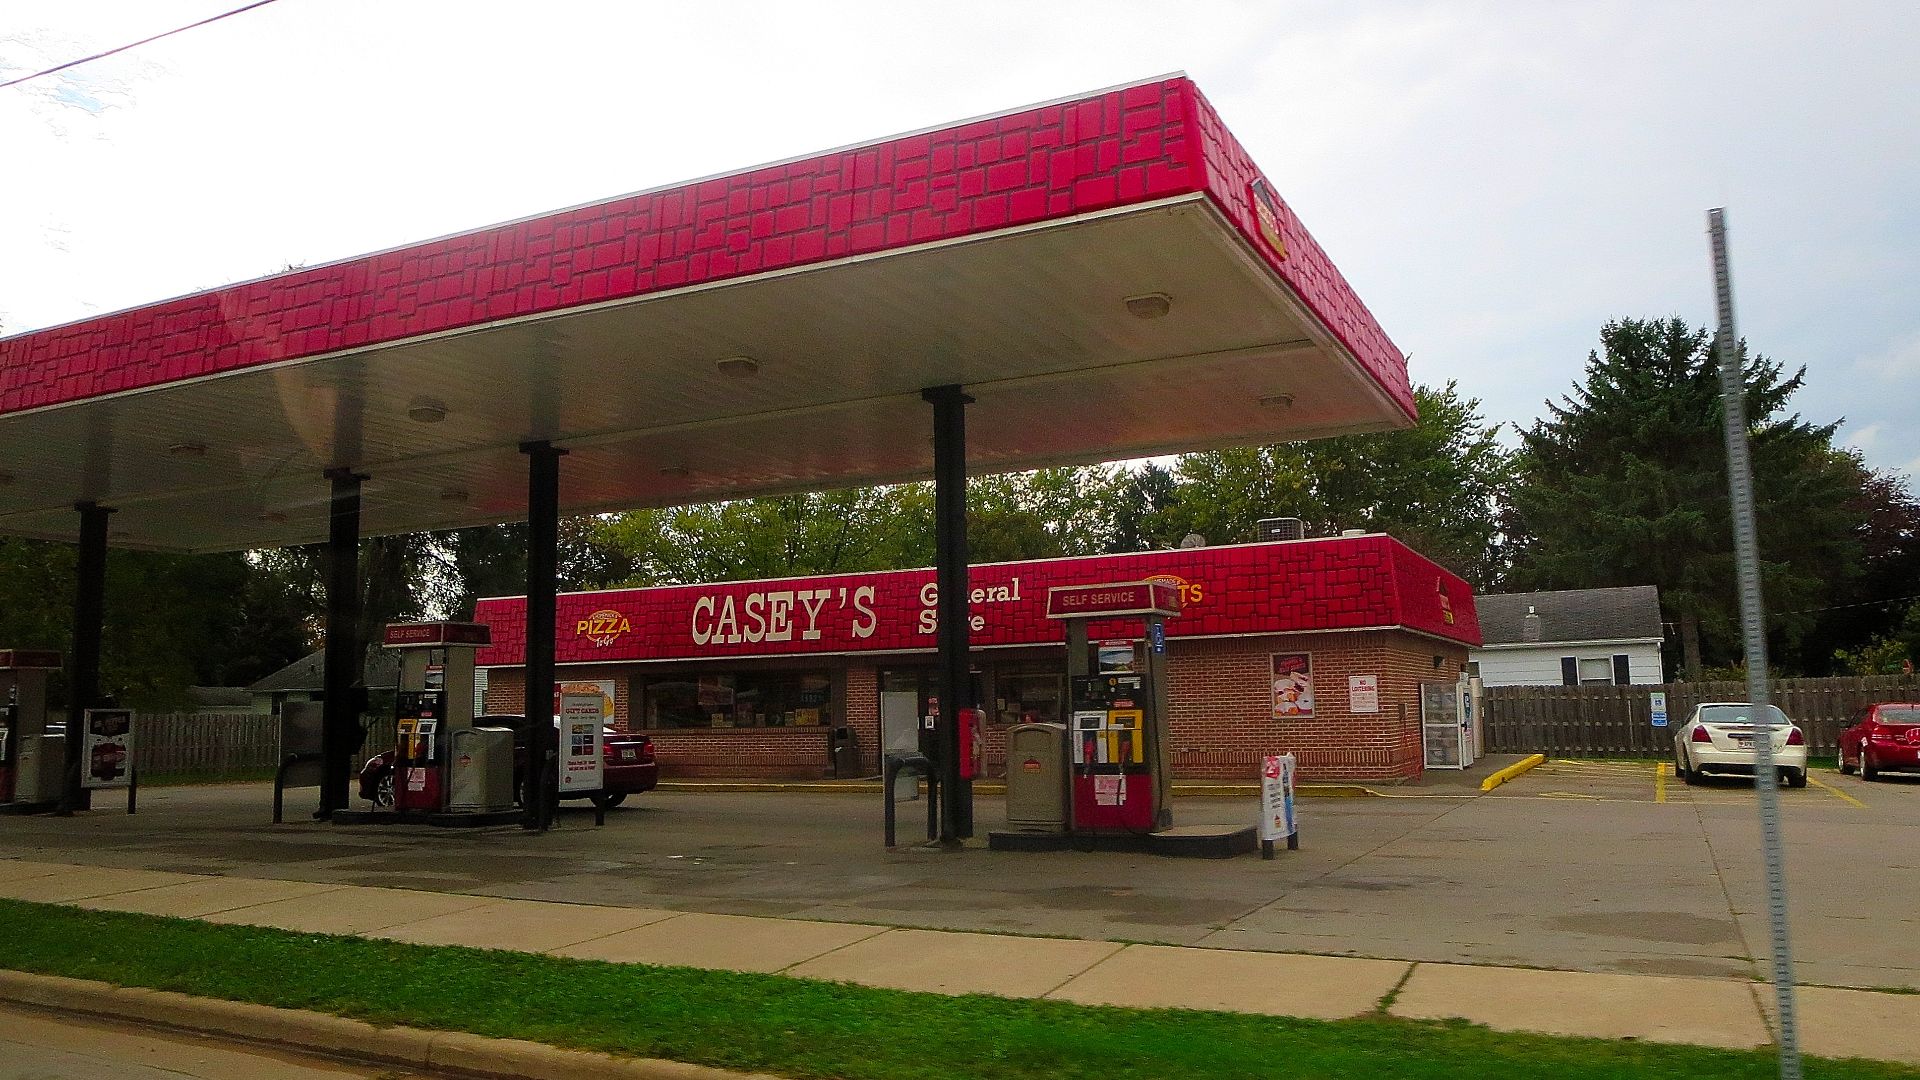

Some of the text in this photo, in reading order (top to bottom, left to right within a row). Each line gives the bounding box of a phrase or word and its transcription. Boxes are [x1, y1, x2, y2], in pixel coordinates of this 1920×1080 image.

[920, 578, 1021, 607] Geral
[1062, 591, 1135, 607] SELF SERVICE
[692, 586, 877, 645] CASEY'S
[390, 628, 430, 639] SELF SERVICE
[576, 618, 631, 635] PIZZA
